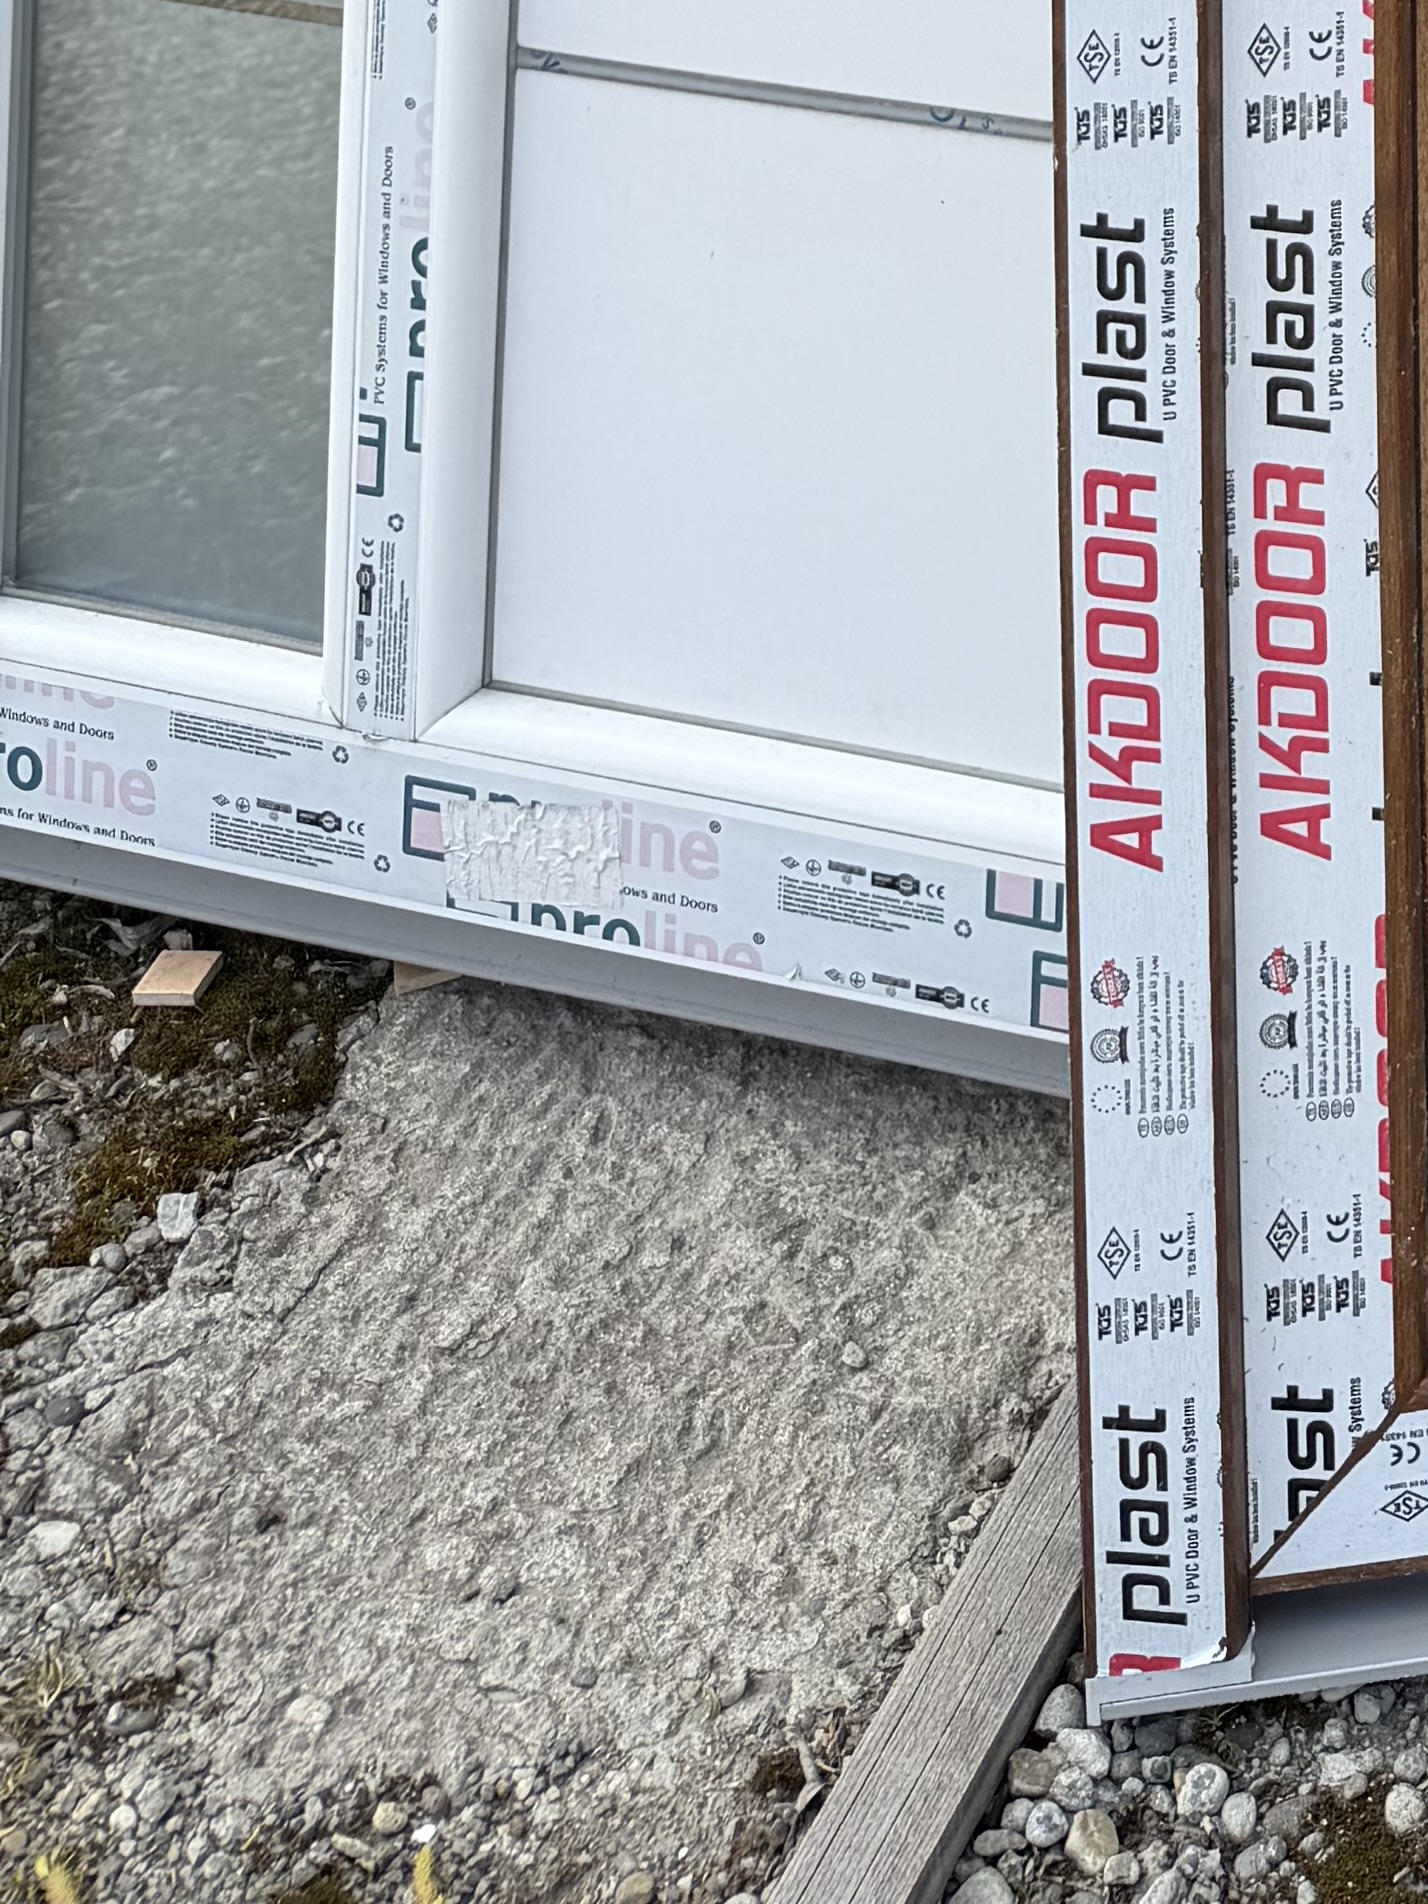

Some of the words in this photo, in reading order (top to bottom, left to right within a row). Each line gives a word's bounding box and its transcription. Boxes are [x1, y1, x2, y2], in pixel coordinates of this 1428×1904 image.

[381, 146, 393, 188] Doors
[381, 192, 392, 219] and
[378, 223, 391, 284] Windows
[376, 289, 388, 310] for
[1249, 203, 1335, 434] plast
[375, 314, 388, 372] Systems
[1079, 212, 1168, 444] plast
[374, 377, 386, 405] PVC
[1082, 470, 1162, 872] AKDOOR
[1252, 463, 1331, 861] AKDOOR
[0, 707, 50, 728] Windows
[52, 720, 75, 733] and
[79, 722, 115, 741] Doors
[1160, 1231, 1183, 1261] CE
[1181, 1397, 1199, 1454] Systems
[1182, 1457, 1198, 1511] Window
[1101, 1404, 1192, 1627] plast
[1183, 1513, 1198, 1524] &
[1185, 1528, 1200, 1560] Door
[1184, 1562, 1200, 1591] PVC
[1185, 1593, 1201, 1604] U
